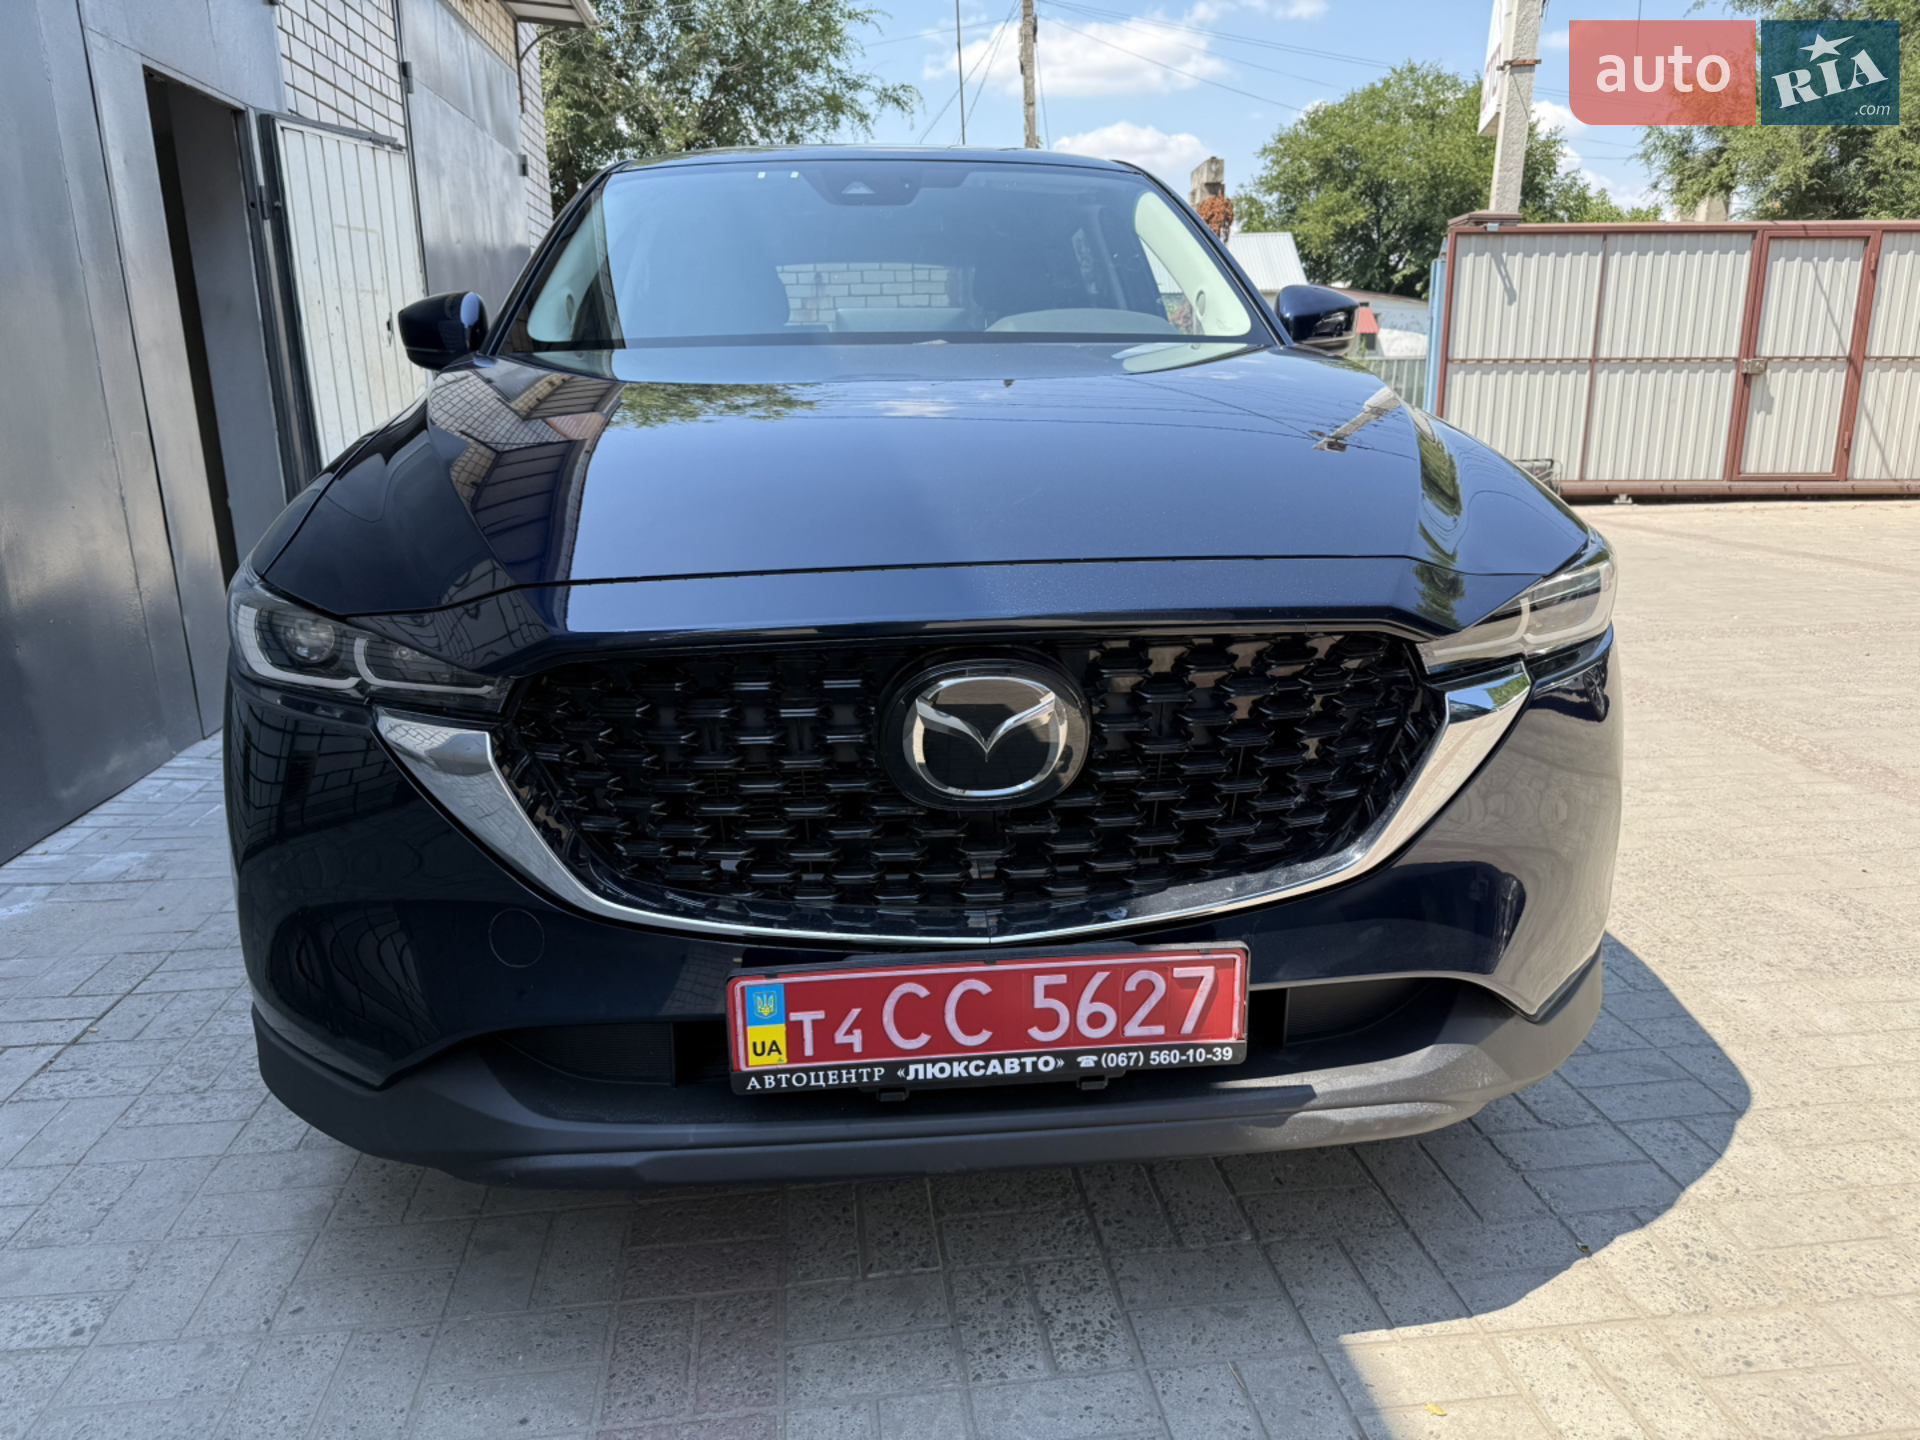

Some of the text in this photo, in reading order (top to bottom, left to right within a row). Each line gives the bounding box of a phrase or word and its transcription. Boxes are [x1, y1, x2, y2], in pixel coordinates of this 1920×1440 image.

[1027, 966, 1215, 1042] 5627
[746, 1046, 1233, 1090] АВТОЦЕНТР «ЛЮКСАВТО» (067) 560-10-39
[752, 1039, 783, 1057] UA
